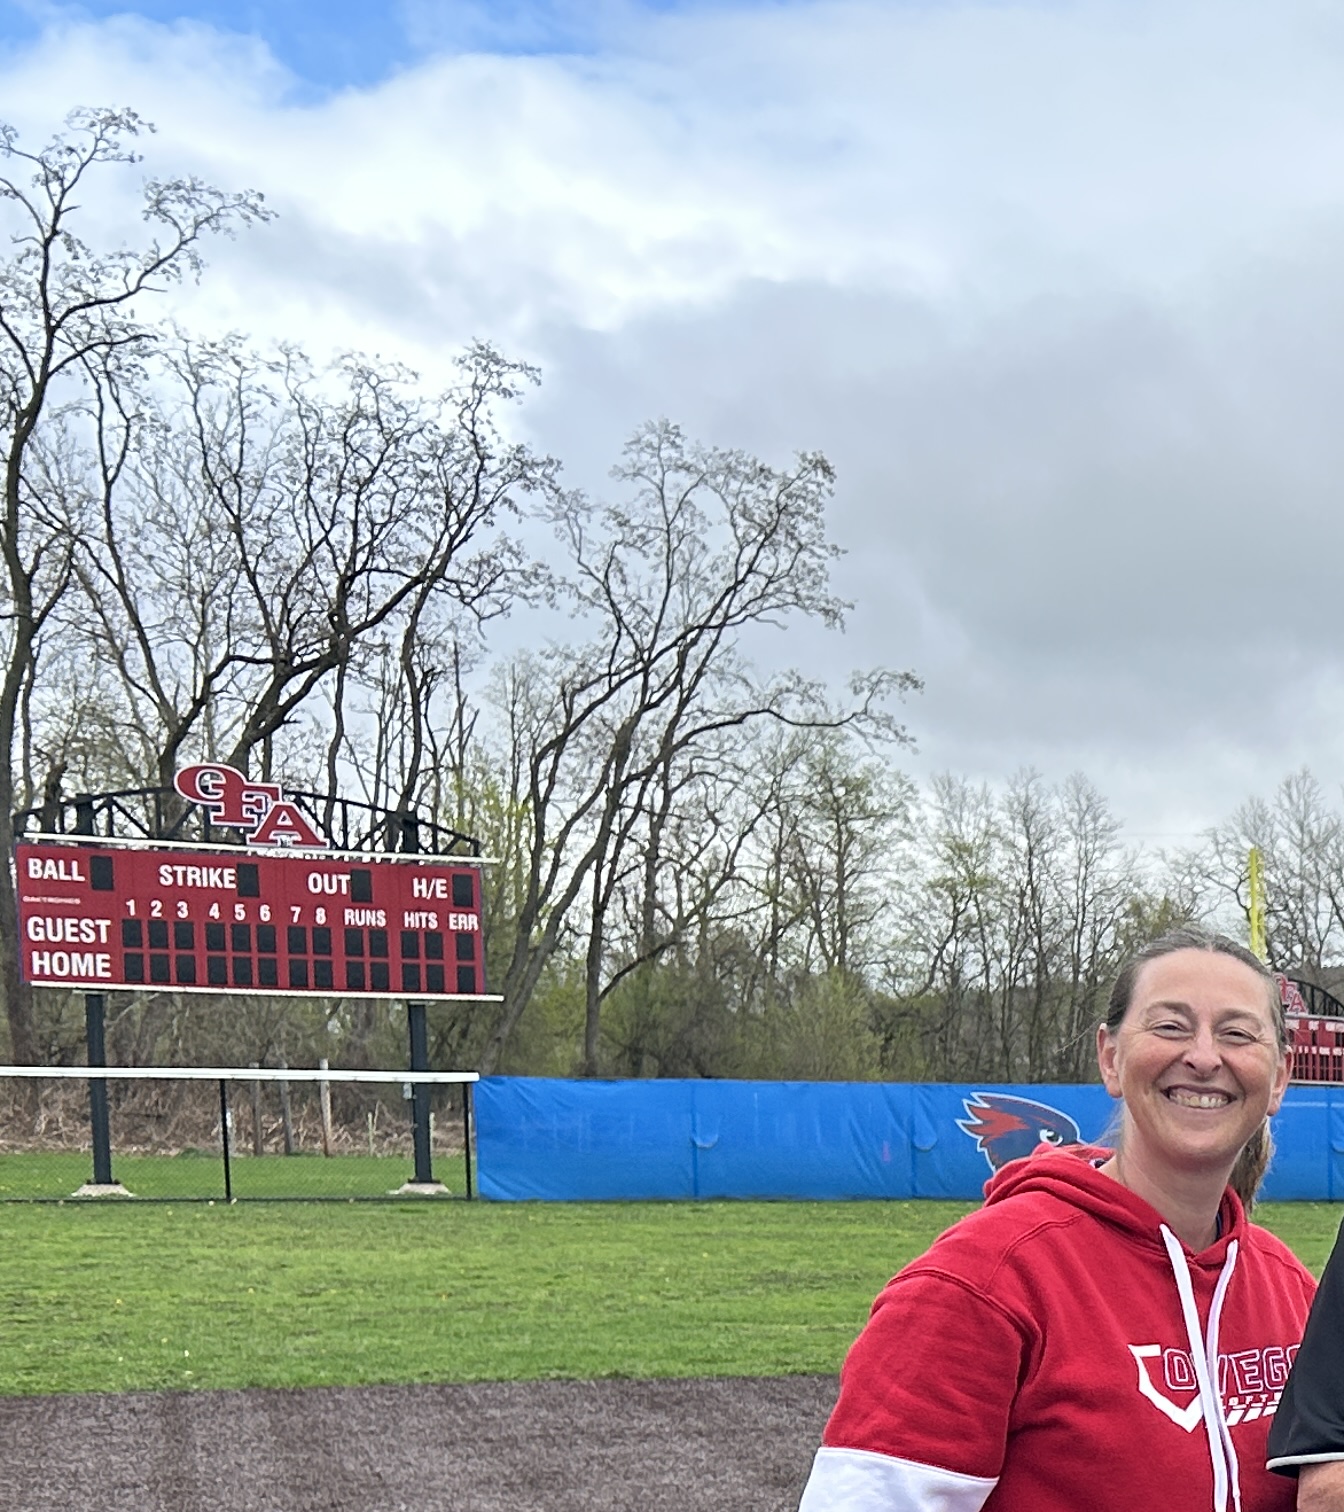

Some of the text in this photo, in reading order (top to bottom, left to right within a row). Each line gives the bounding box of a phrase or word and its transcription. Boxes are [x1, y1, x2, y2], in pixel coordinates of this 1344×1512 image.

[27, 857, 448, 900] BALL STRIKE OUT H/E
[27, 916, 112, 944] GUEST
[126, 899, 479, 931] 1 2 3 4 5 6 7 8 RUNS HITS ERR
[31, 950, 112, 978] HOME
